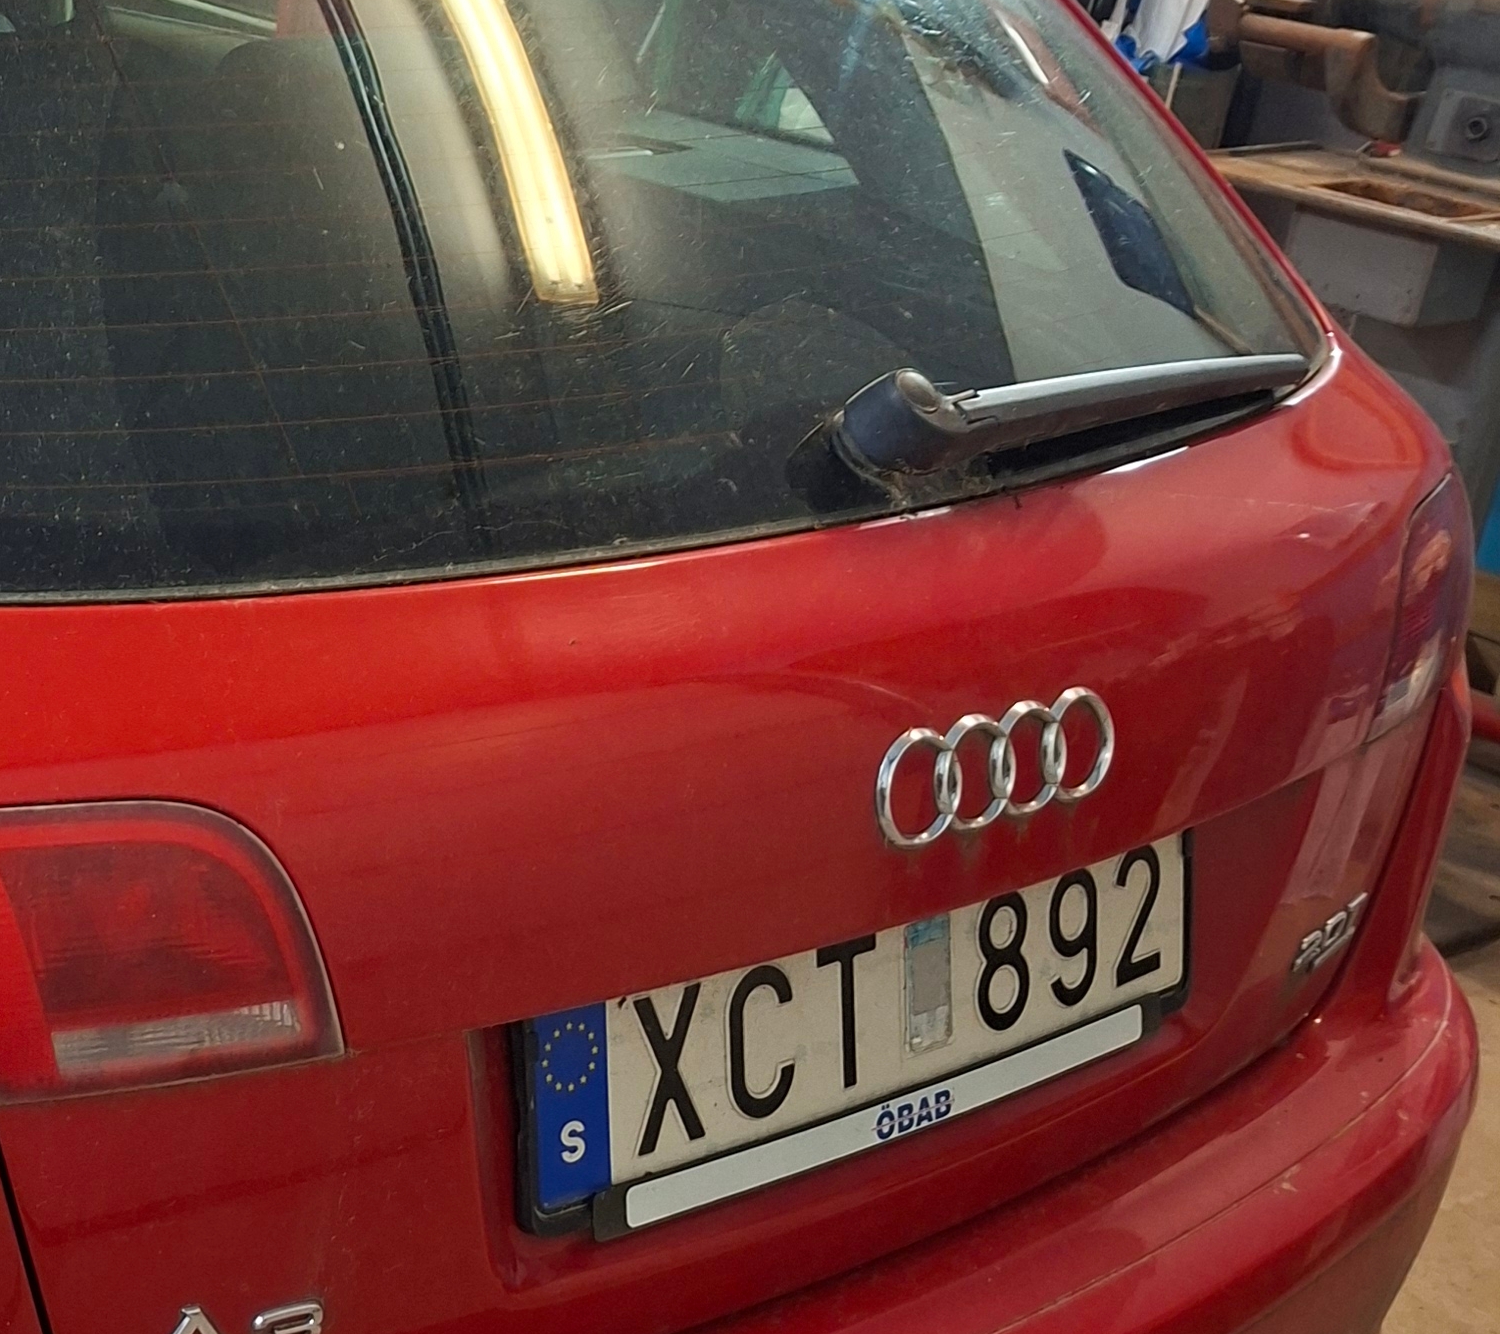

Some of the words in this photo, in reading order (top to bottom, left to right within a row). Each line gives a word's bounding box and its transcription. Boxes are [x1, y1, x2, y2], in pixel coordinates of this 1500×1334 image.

[632, 932, 878, 1157] XCT
[977, 844, 1161, 1032] 892
[874, 1088, 953, 1141] ÖBAB
[559, 1119, 587, 1164] S
